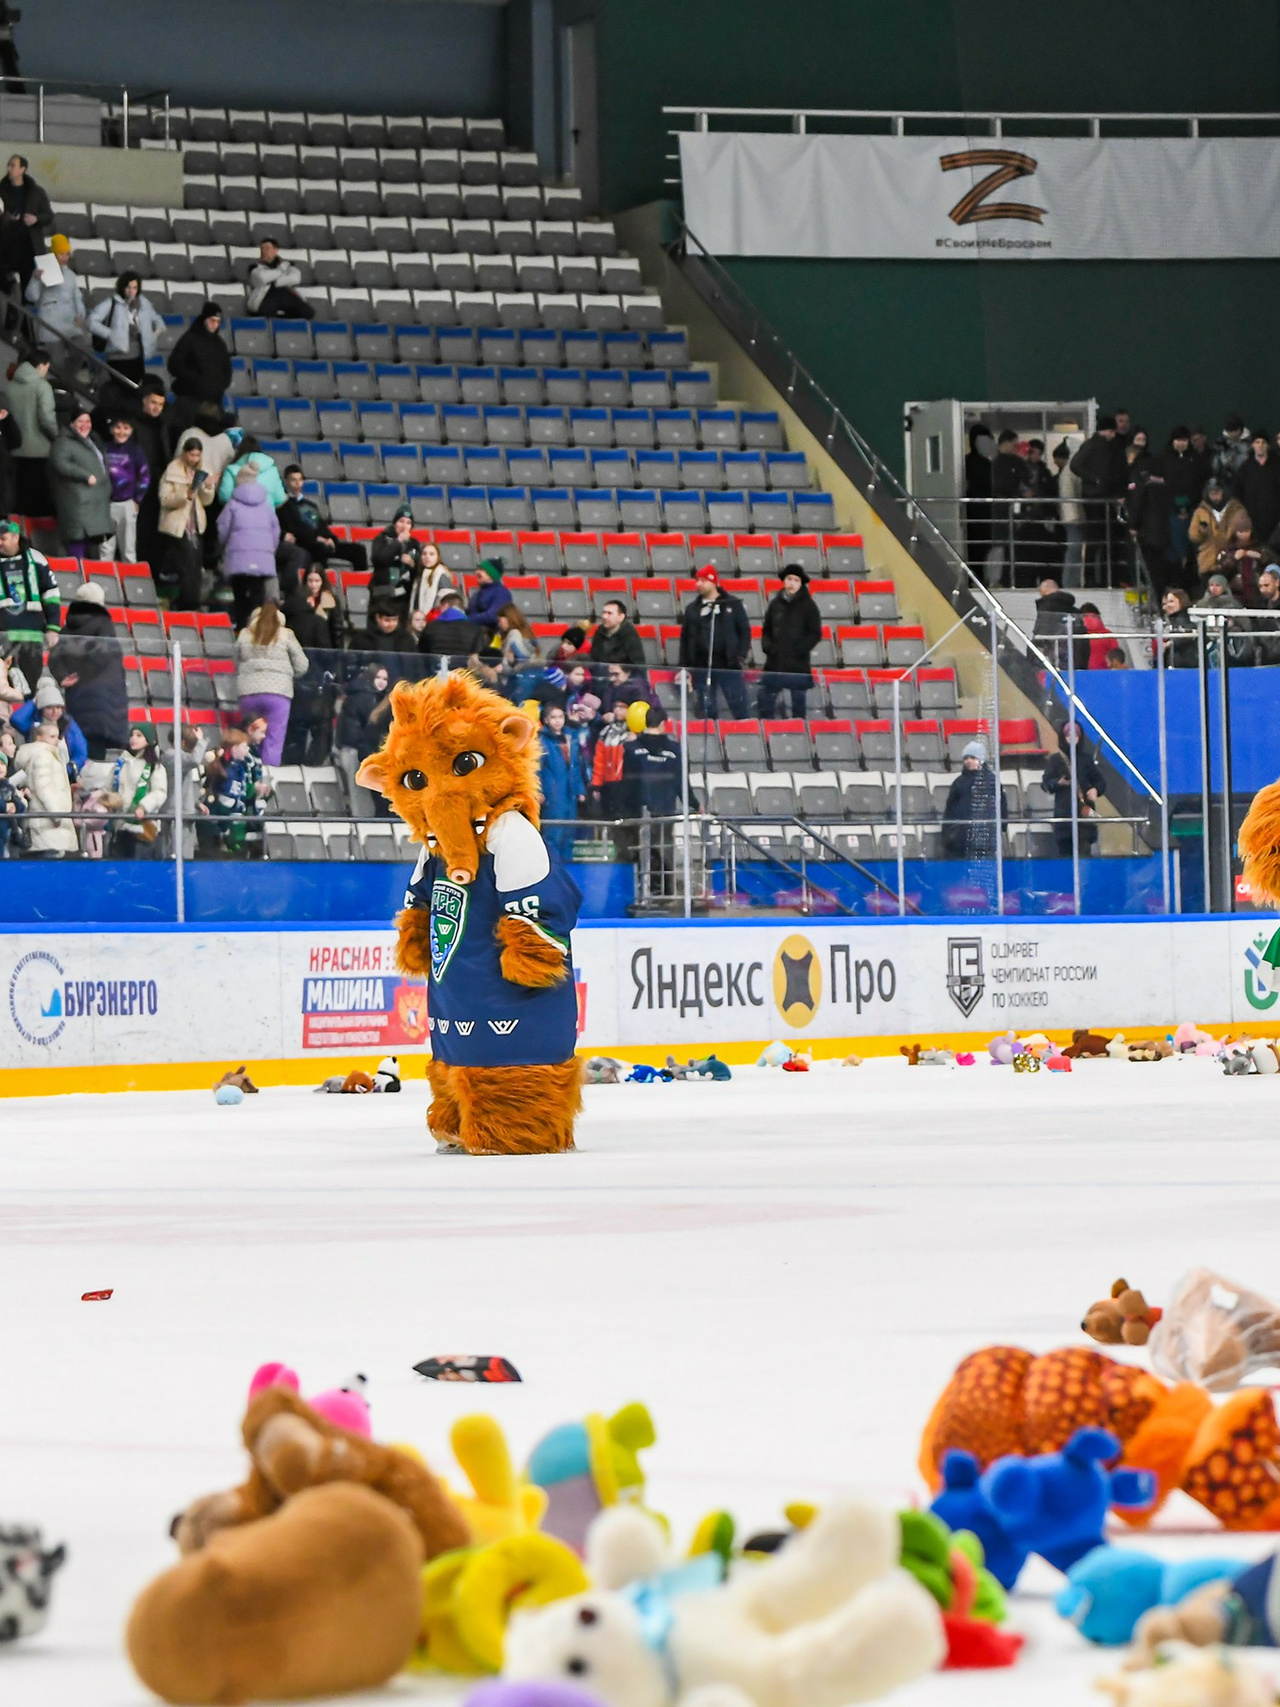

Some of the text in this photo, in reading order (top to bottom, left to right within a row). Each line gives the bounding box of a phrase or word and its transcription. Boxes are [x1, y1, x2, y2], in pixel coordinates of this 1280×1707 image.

[309, 946, 382, 972] КРАСНАЯ
[991, 942, 1039, 959] OLIMPBET
[631, 944, 896, 1018] Яндекс Про
[991, 966, 1051, 984] ЧЕМПИОНАТ
[1054, 965, 1098, 982] РОССИИ
[64, 979, 158, 1017] БУРЭНЕРГО
[306, 978, 385, 1012] МАШИНА
[992, 991, 1049, 1008] ПО ХОККЕЮ
